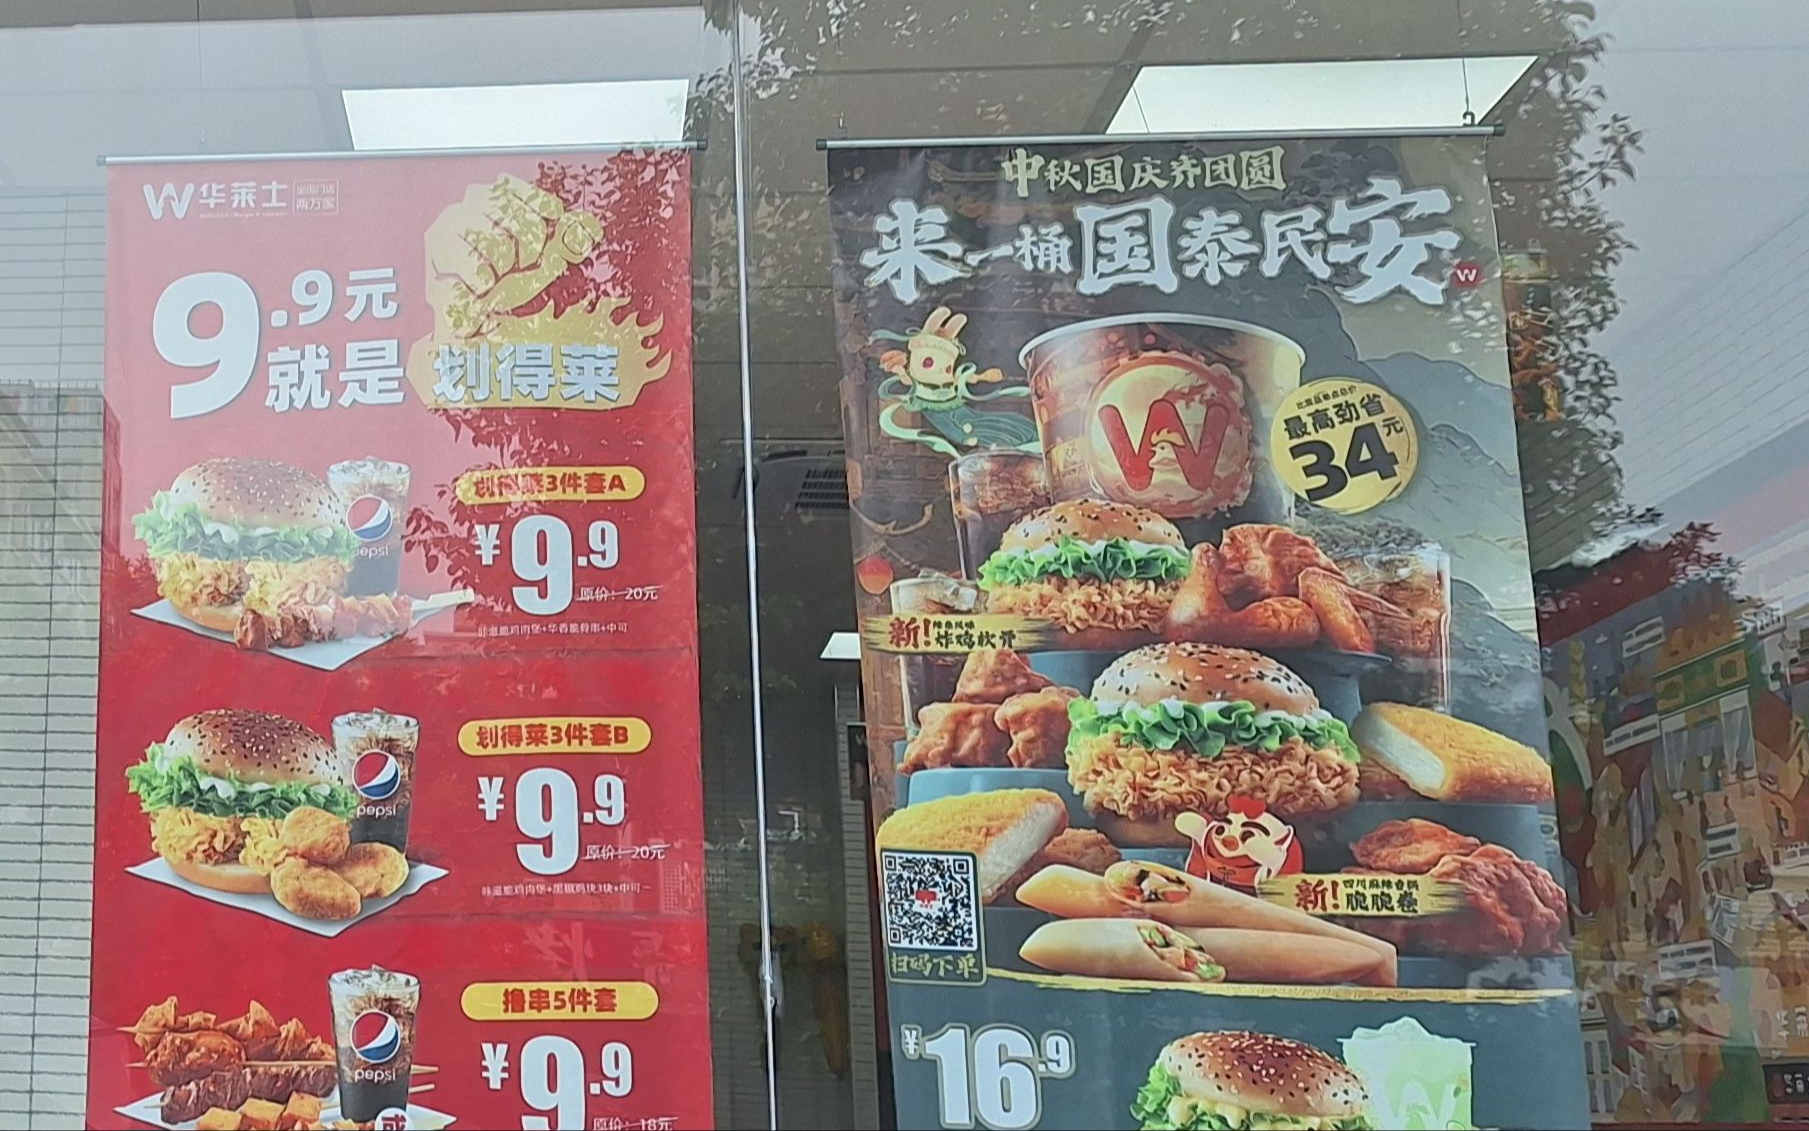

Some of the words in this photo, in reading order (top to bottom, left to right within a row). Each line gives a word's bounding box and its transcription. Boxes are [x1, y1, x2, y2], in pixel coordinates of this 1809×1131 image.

[1003, 146, 1288, 199] 中秋国庆齐团圆
[199, 181, 288, 209] 华莱士
[861, 178, 1462, 306] 来一桶国泰民安
[1283, 393, 1385, 441] 最高劲省
[356, 804, 397, 819] pepsi
[892, 951, 979, 979] 扫码下单
[502, 987, 618, 1013] 撸串5件套
[354, 1067, 397, 1083] pepsi
